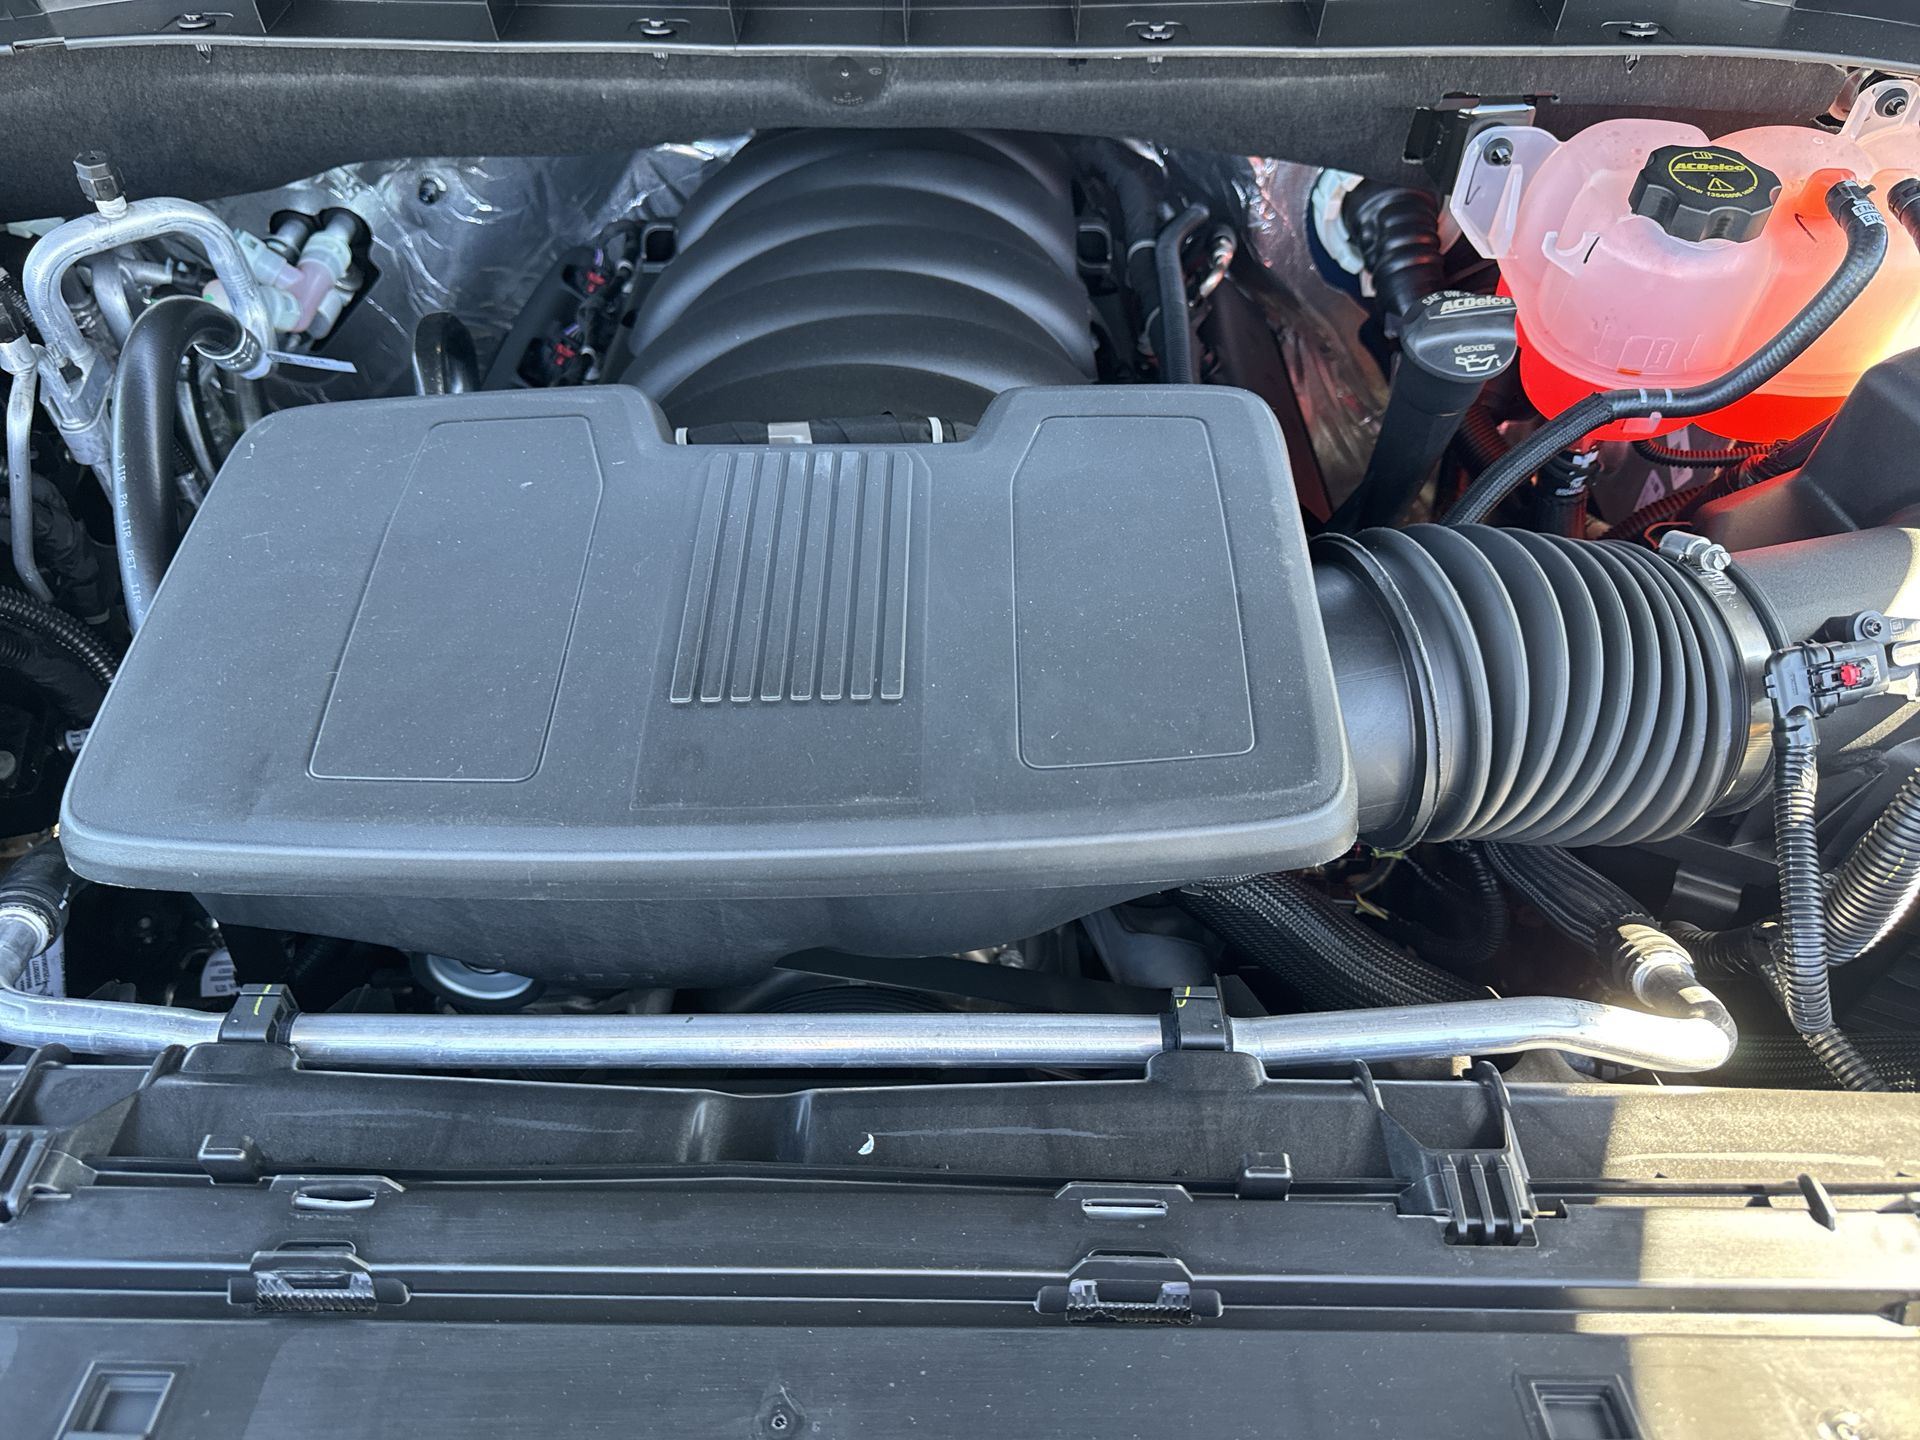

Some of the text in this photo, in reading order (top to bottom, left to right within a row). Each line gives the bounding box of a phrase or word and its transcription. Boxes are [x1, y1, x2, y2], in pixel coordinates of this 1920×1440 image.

[1674, 162, 1746, 172] ACDelco
[1422, 293, 1441, 306] SAE
[1440, 295, 1512, 312] ACDelco
[126, 549, 137, 570] PET
